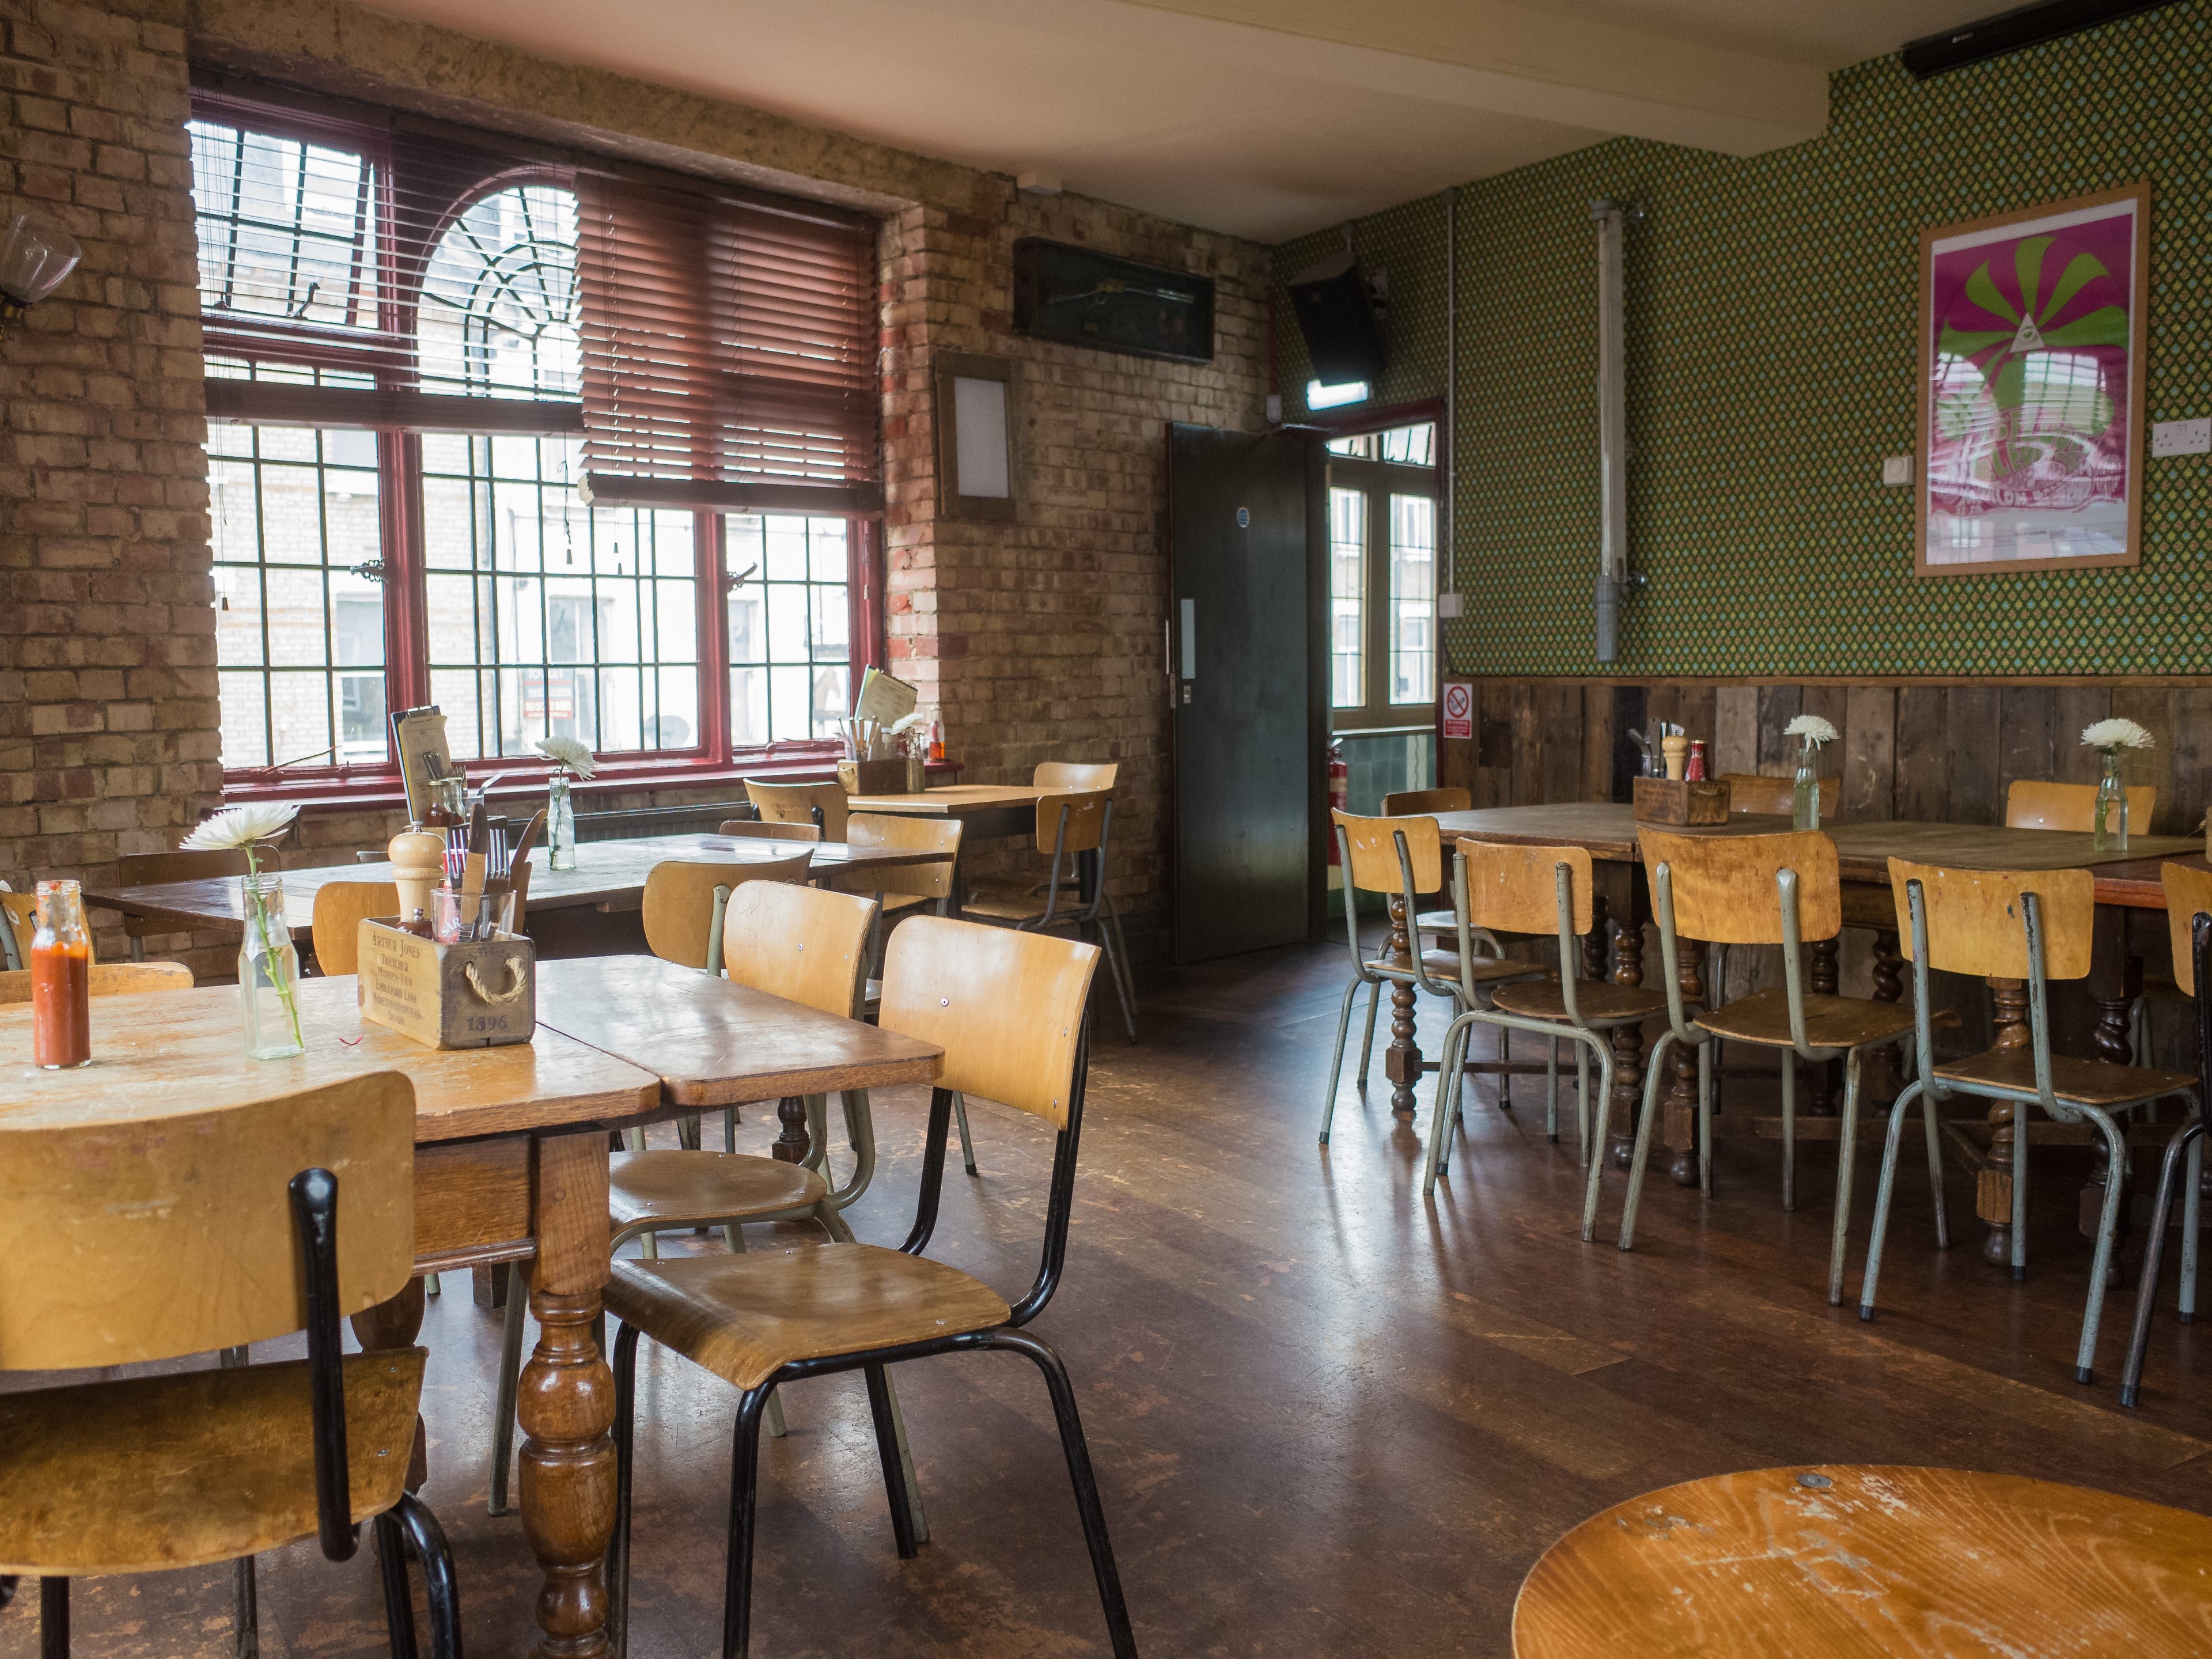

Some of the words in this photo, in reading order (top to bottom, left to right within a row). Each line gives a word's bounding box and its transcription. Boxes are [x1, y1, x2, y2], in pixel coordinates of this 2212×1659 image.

[372, 931, 397, 952] ARTHUR
[400, 940, 420, 959] JONES
[381, 953, 408, 972] THATCHER
[404, 988, 418, 1004] LANE
[466, 1014, 508, 1032] 1896
